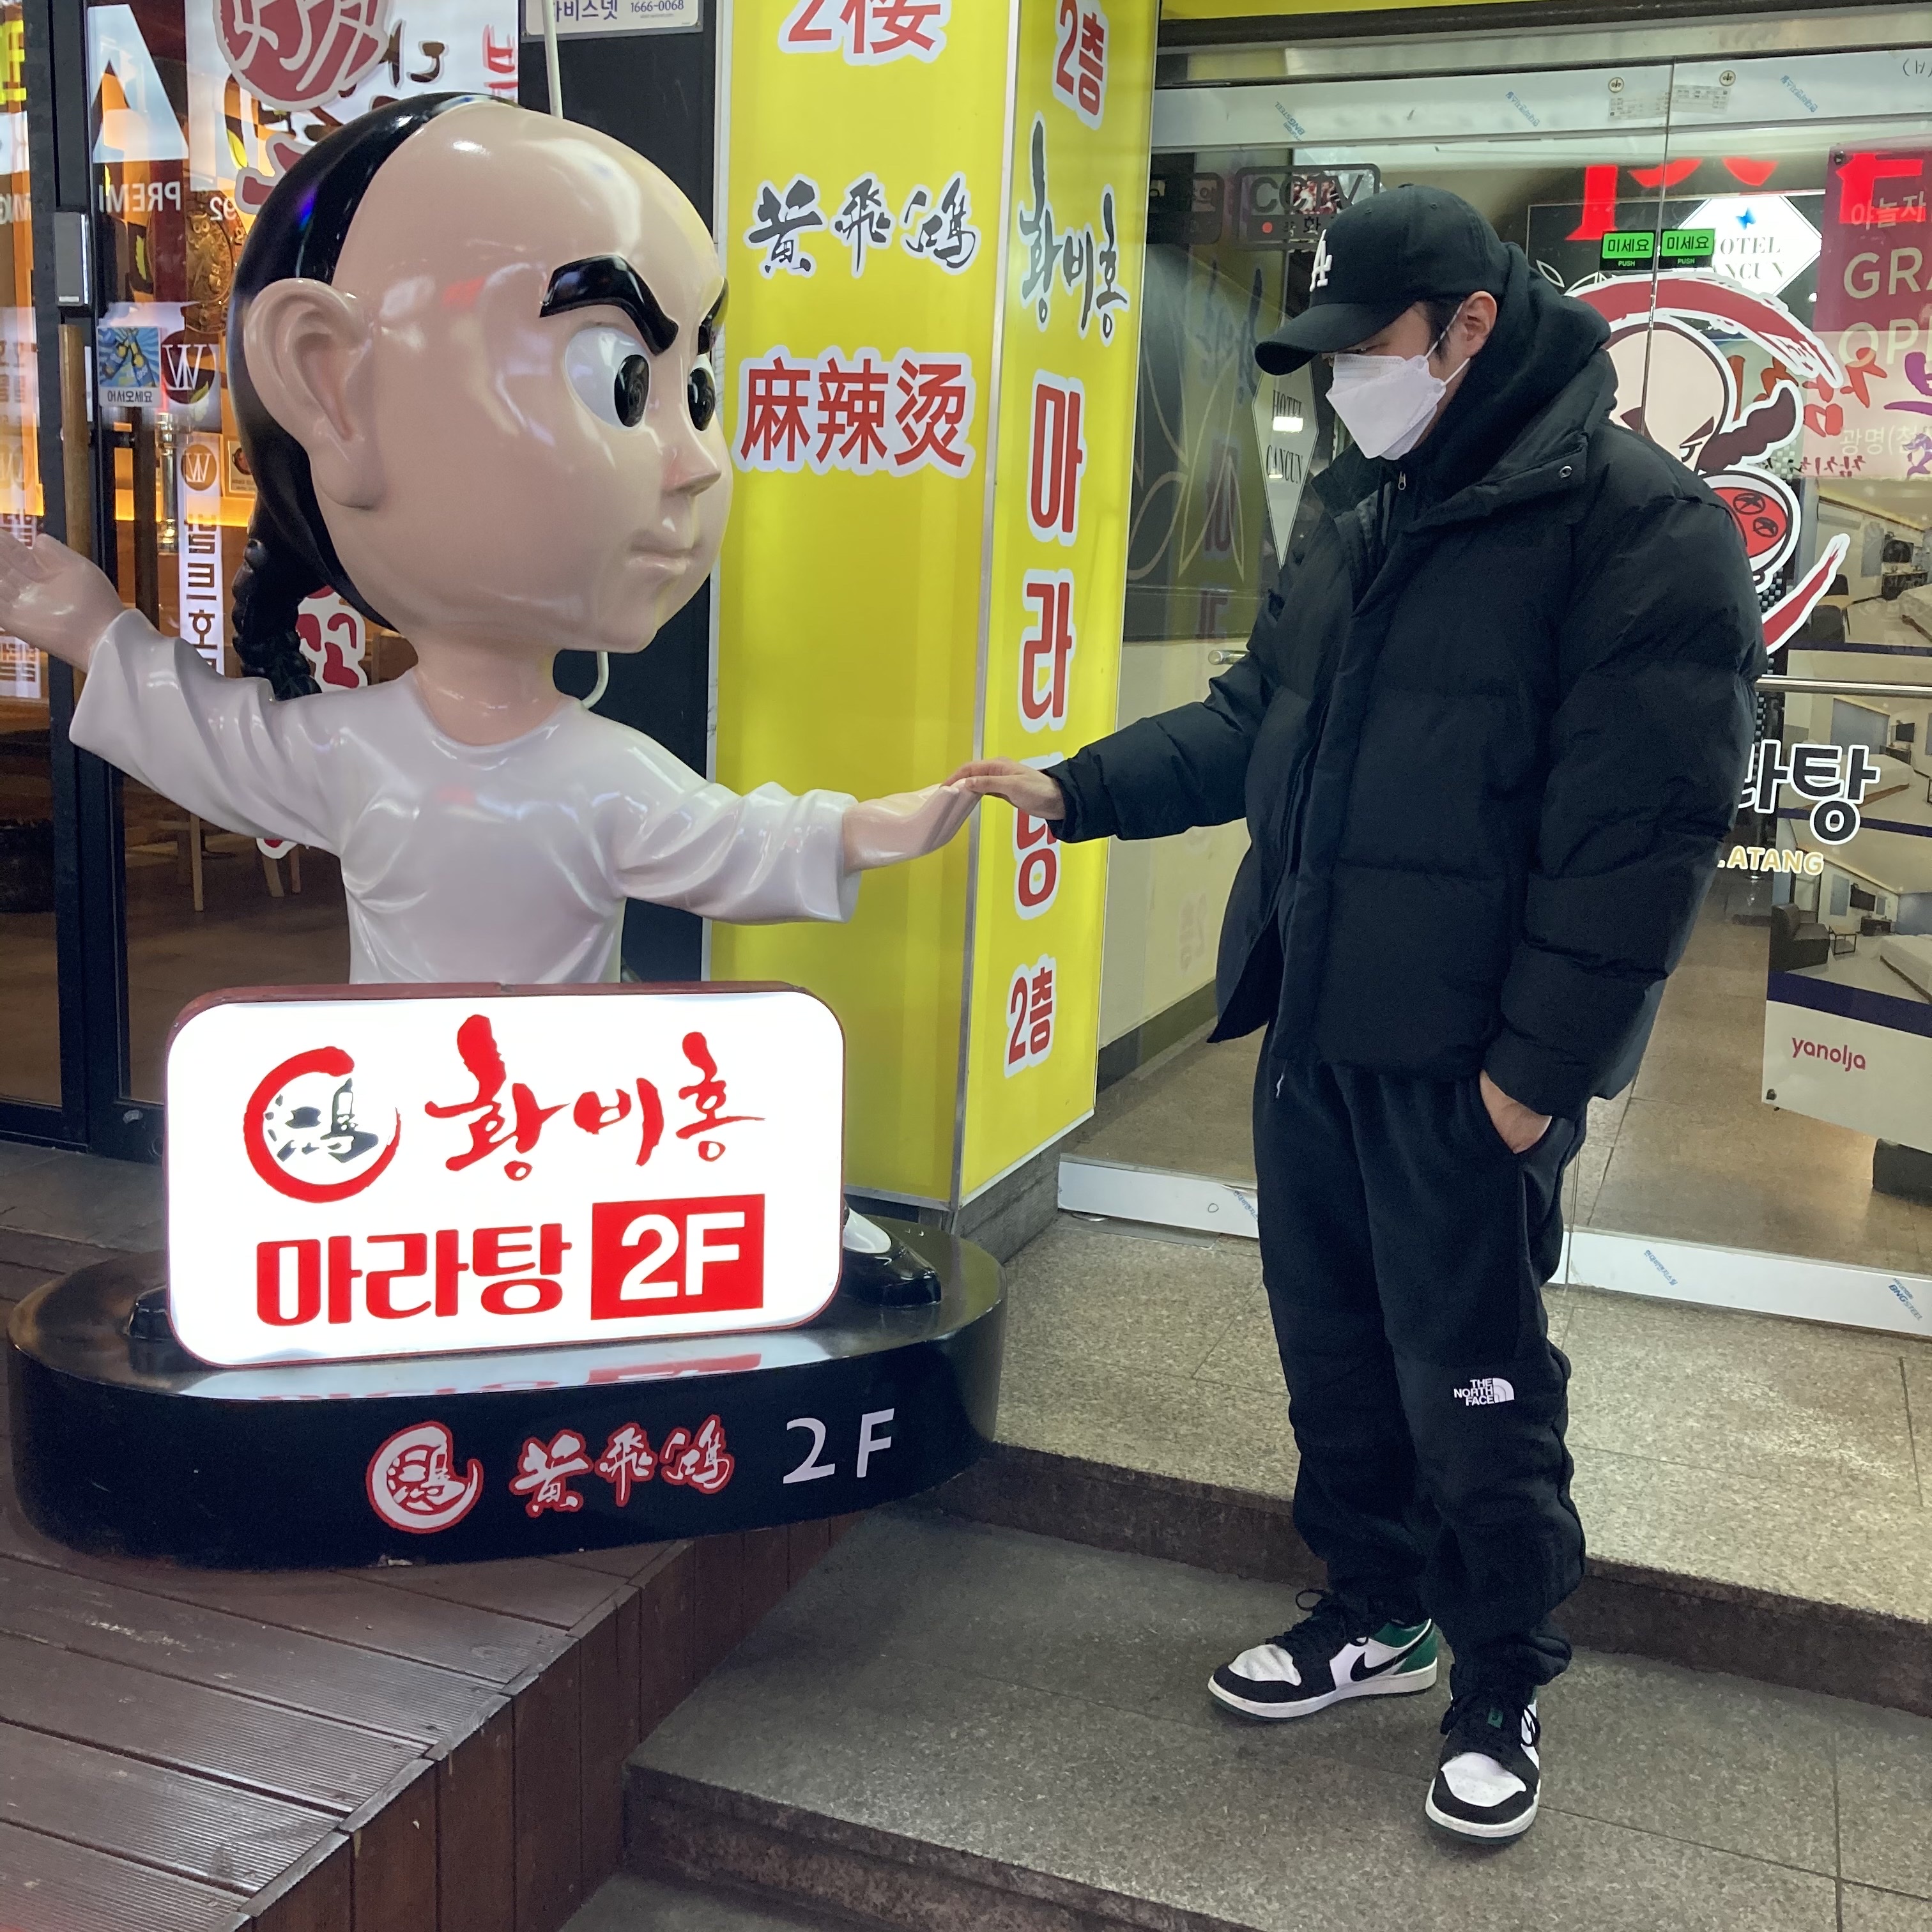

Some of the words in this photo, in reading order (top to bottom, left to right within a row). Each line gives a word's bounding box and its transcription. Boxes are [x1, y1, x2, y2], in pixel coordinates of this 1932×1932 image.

[631, 0, 684, 13] 1666-0068
[1056, 0, 1105, 116] 2층
[1250, 172, 1365, 215] CCTV
[1850, 191, 1927, 231] 야놀자
[1020, 119, 1128, 339] 황비홍
[1607, 238, 1650, 252] 미세요
[1666, 236, 1709, 250] 미세요
[1715, 236, 1781, 255] OTEL
[1309, 229, 1333, 292] LA
[1724, 262, 1784, 280] NCUN
[1843, 247, 1932, 300] GR
[1838, 315, 1932, 368] OP
[107, 390, 153, 403] 어서오세요
[740, 356, 967, 466] 麻辣烫
[1839, 425, 1932, 456] 광명(철
[1717, 845, 1825, 876] ATANG
[1009, 967, 1053, 1065] 2층
[1791, 1037, 1866, 1072] yanolja
[424, 1014, 766, 1182] 황비홍
[256, 1223, 572, 1327] 마라탕
[620, 1211, 746, 1301] 2F
[1453, 1386, 1494, 1398] NORTH
[1470, 1377, 1492, 1388] THE
[1466, 1395, 1495, 1406] FACE
